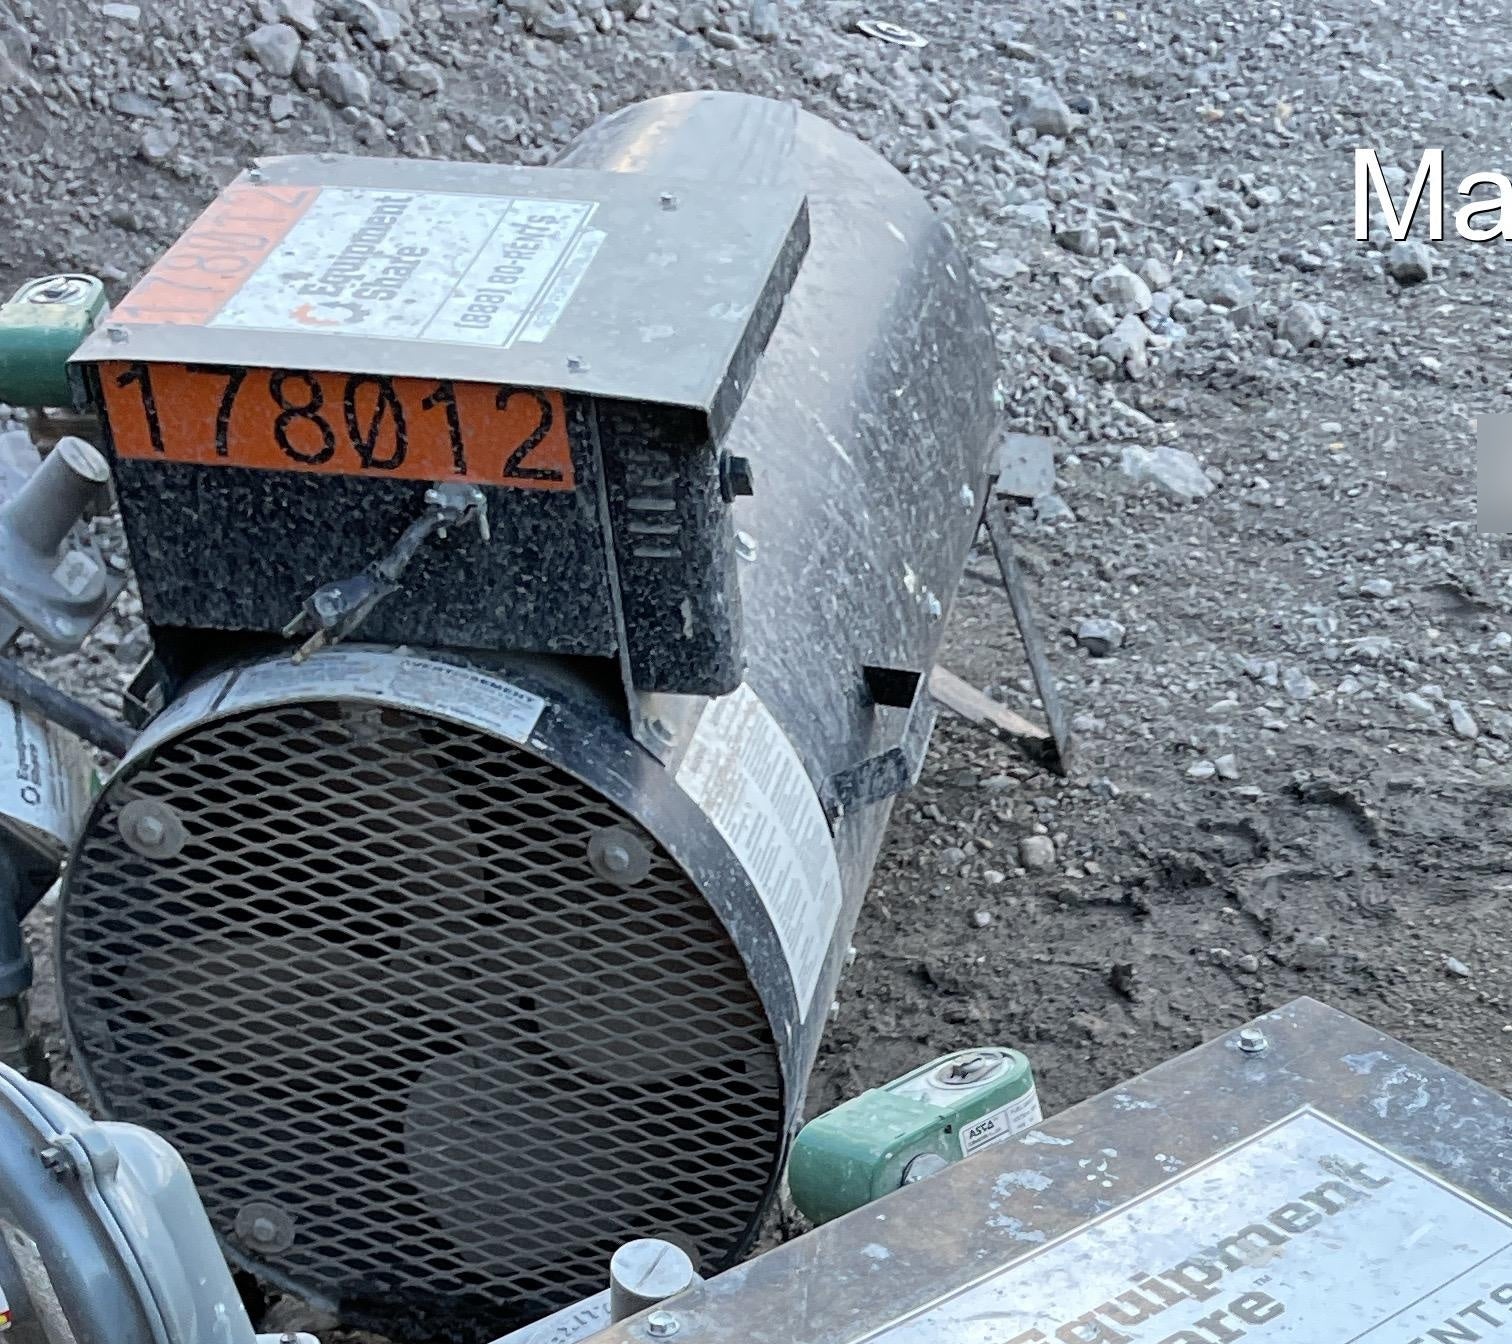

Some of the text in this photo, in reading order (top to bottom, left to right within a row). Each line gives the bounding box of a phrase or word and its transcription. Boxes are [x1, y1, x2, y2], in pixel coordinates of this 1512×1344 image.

[297, 195, 413, 296] Equipment
[352, 246, 429, 300] Share
[453, 288, 512, 329] (888)
[115, 361, 564, 483] 178012
